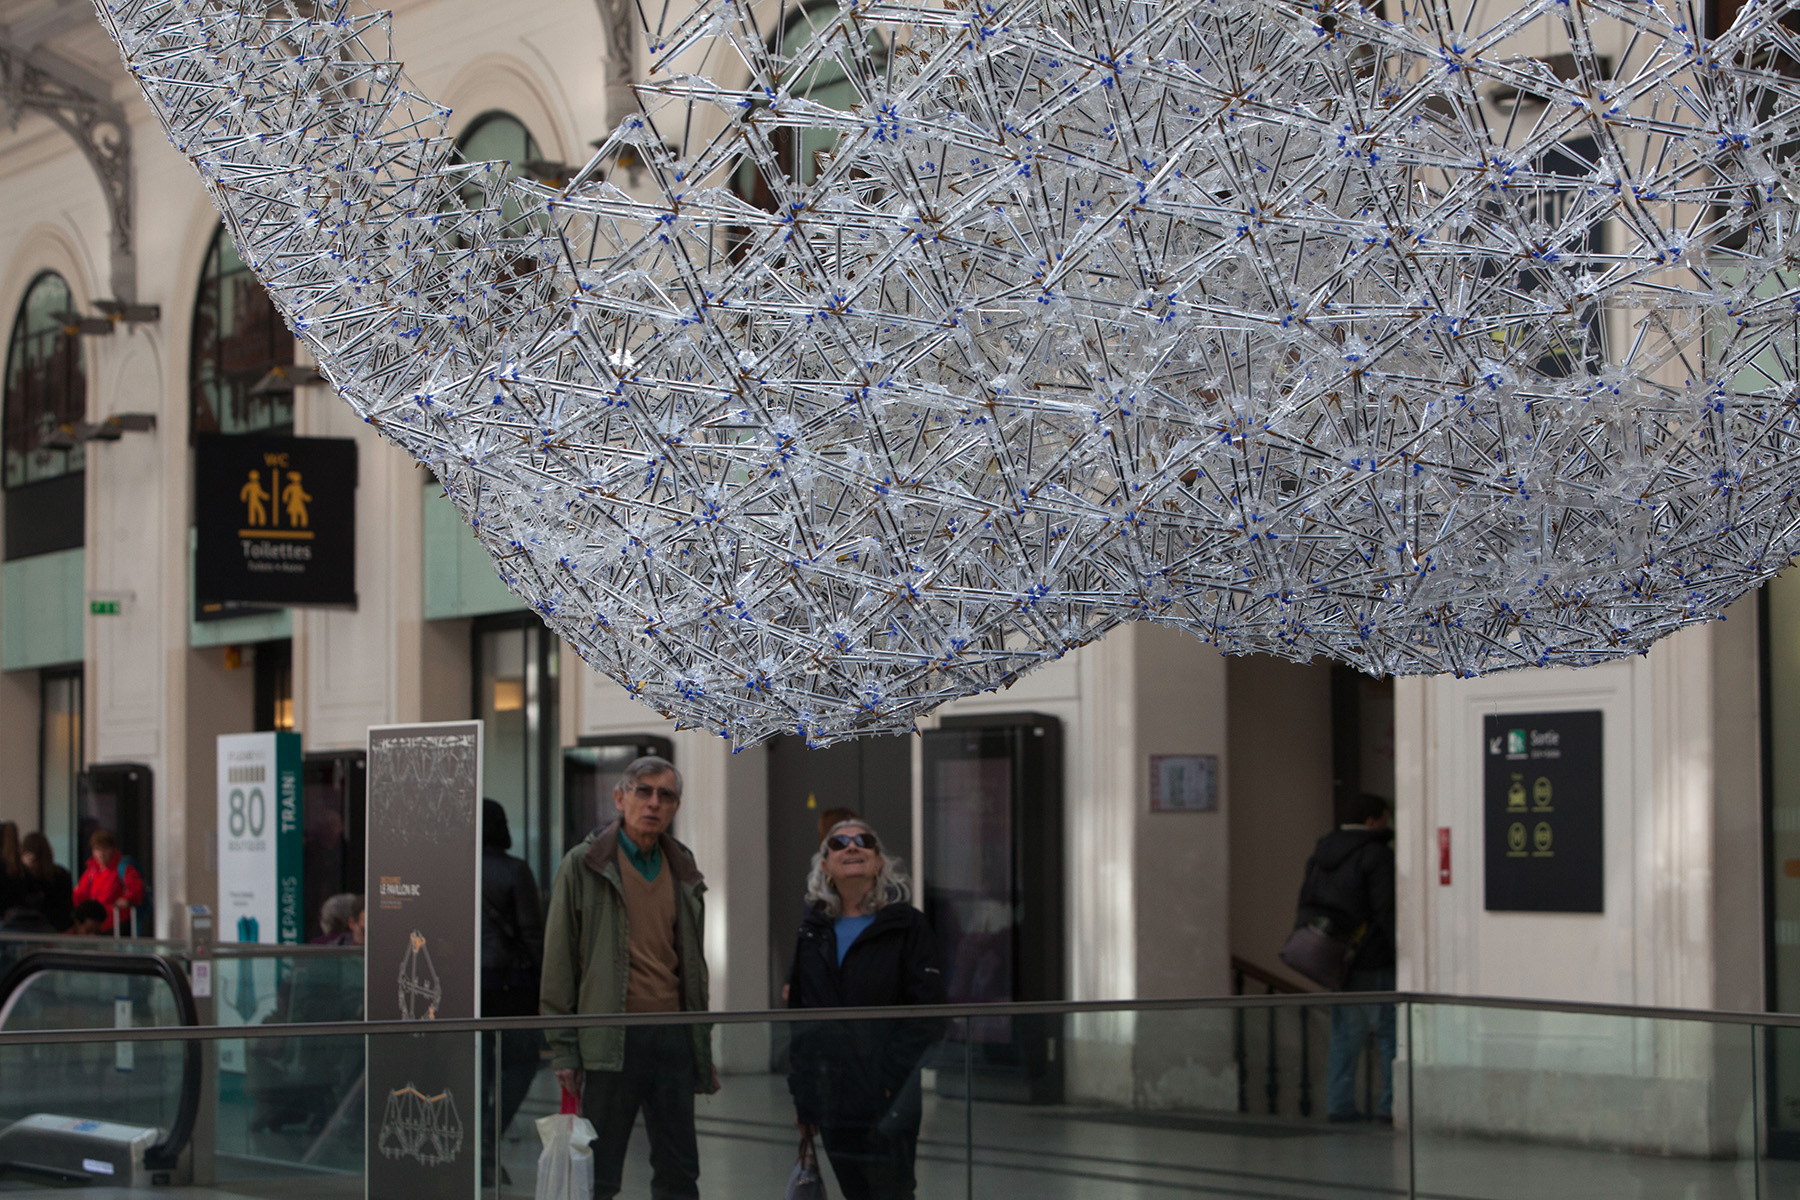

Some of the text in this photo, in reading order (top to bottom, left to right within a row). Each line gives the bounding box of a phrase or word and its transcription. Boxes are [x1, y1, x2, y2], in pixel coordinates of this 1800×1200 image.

[263, 452, 289, 468] WC
[240, 540, 312, 560] Toilettes
[229, 787, 266, 837] 80
